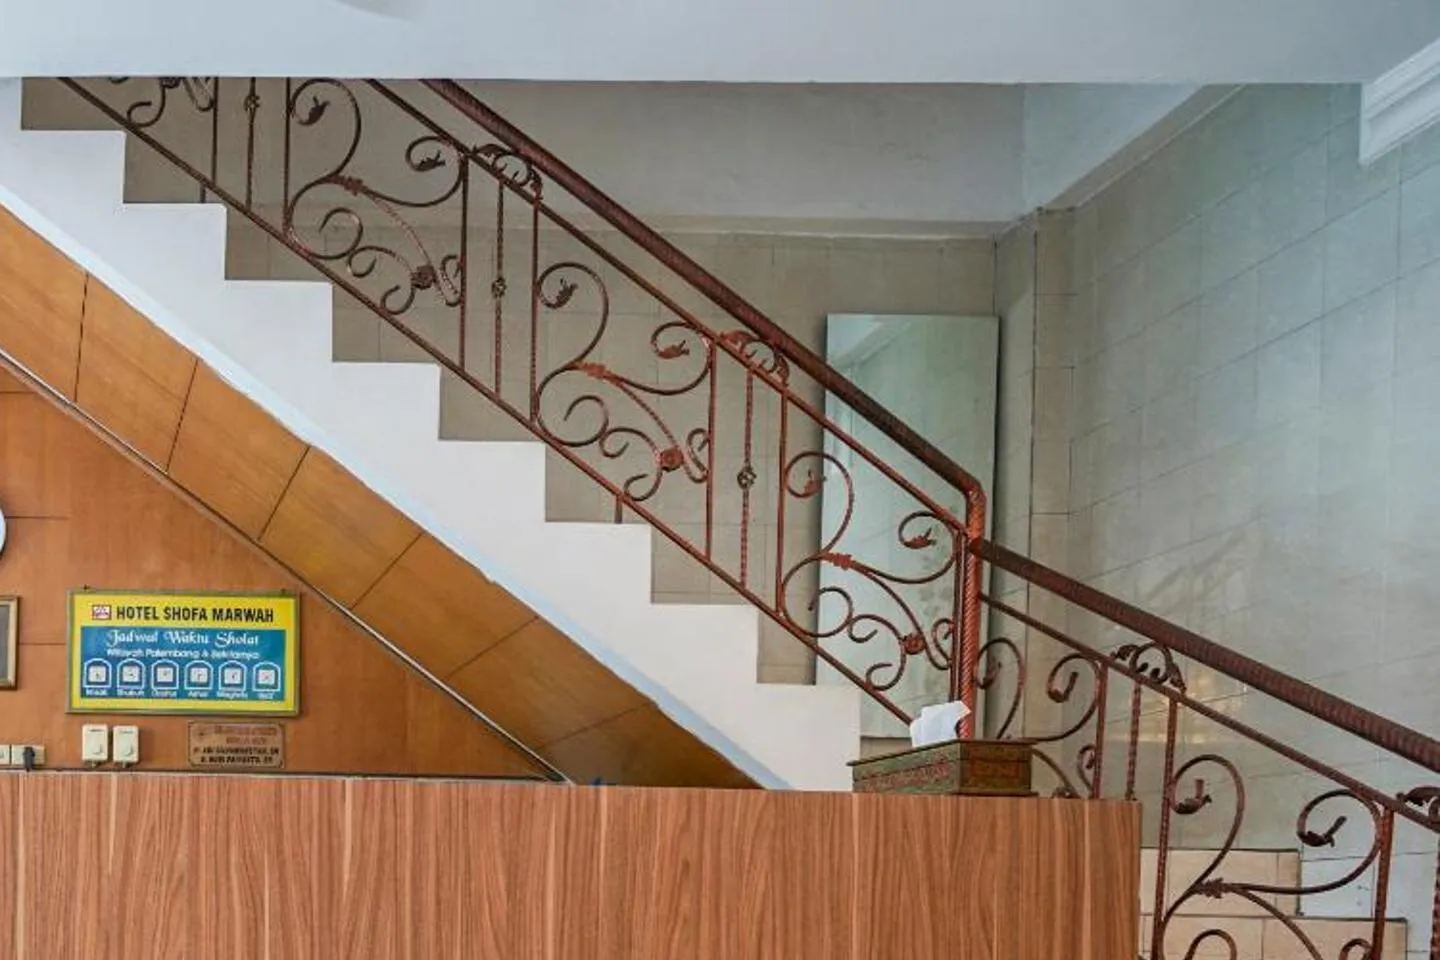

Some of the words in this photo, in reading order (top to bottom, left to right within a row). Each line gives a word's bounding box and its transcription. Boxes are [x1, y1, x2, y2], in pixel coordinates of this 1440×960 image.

[116, 606, 159, 620] HOTEL
[163, 607, 208, 621] SHOFA
[212, 608, 274, 622] MARWAH
[106, 629, 158, 647] Jadwal
[164, 630, 208, 645] Waktu
[214, 631, 259, 648] Sholat
